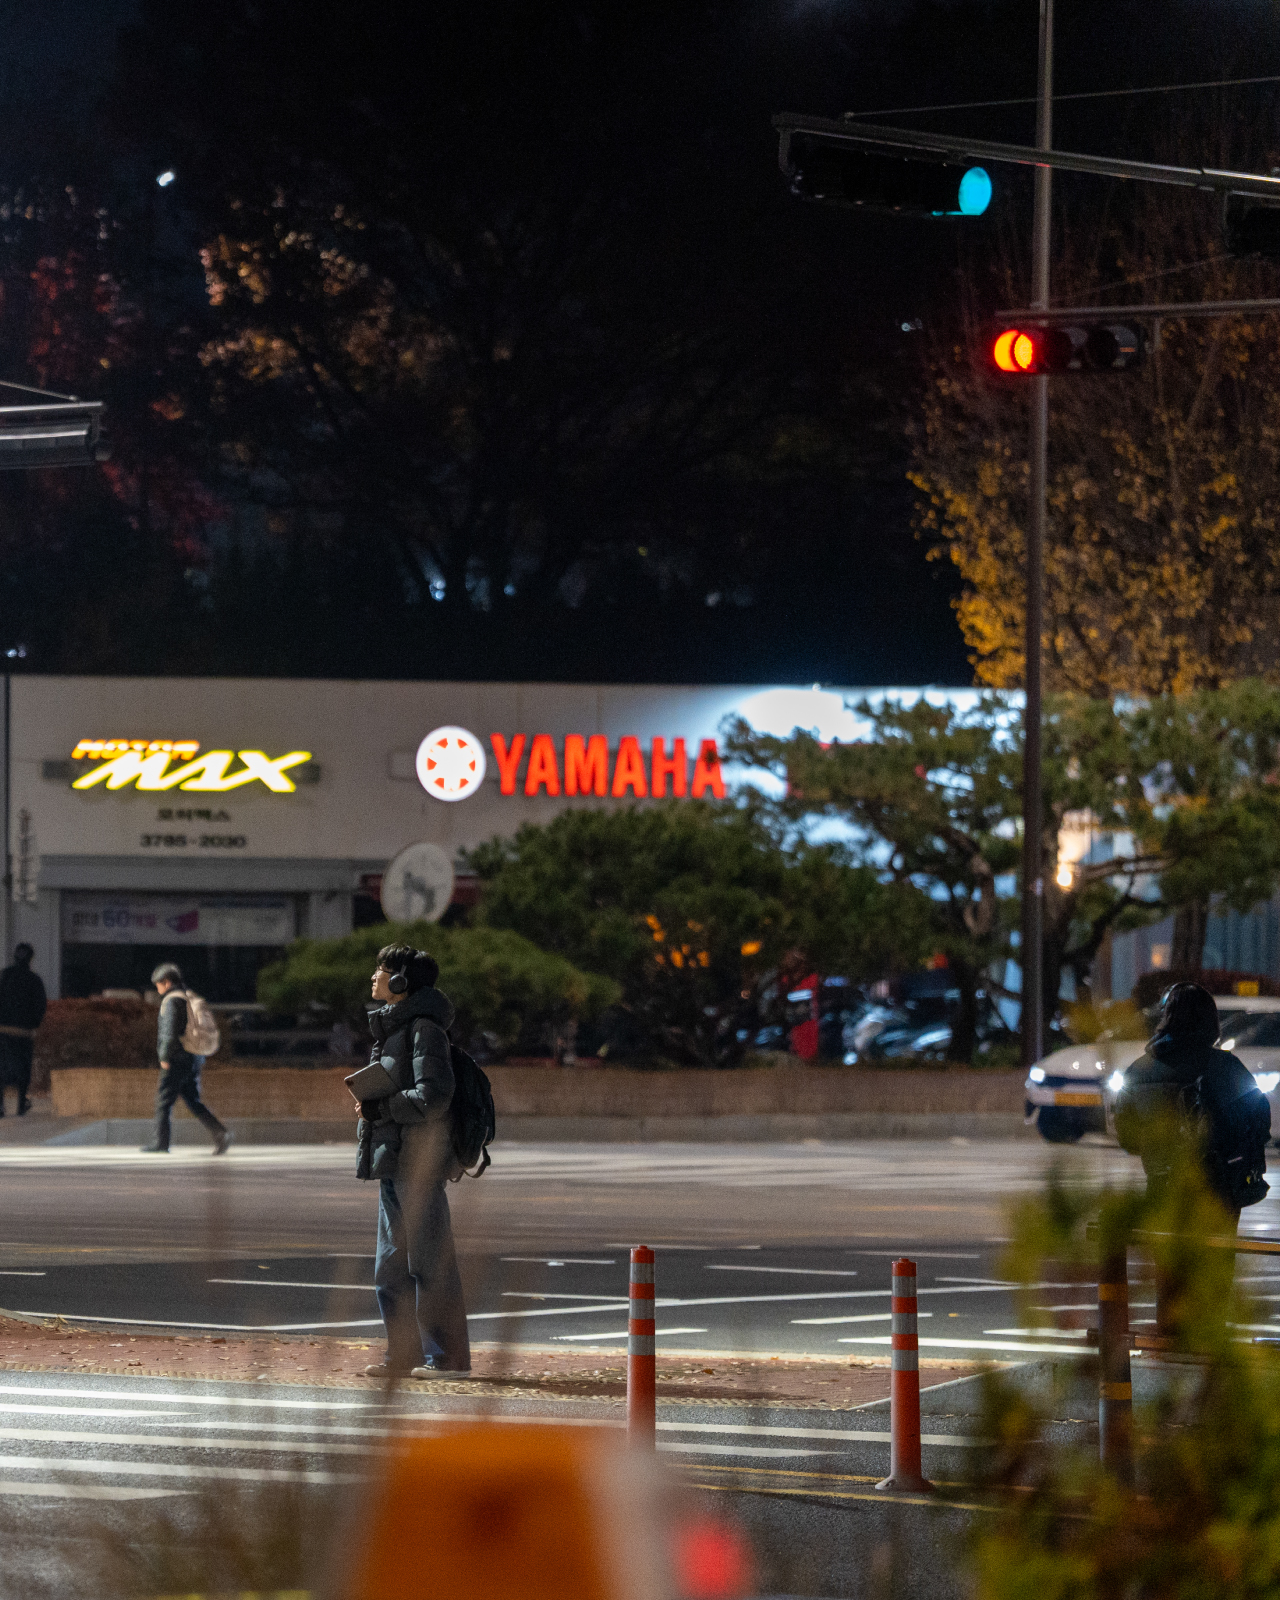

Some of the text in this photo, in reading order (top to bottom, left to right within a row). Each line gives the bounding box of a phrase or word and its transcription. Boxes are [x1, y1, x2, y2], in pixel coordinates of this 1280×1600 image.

[71, 739, 200, 760] MOTOR
[72, 749, 313, 793] MAX
[490, 731, 727, 799] YAMAHA
